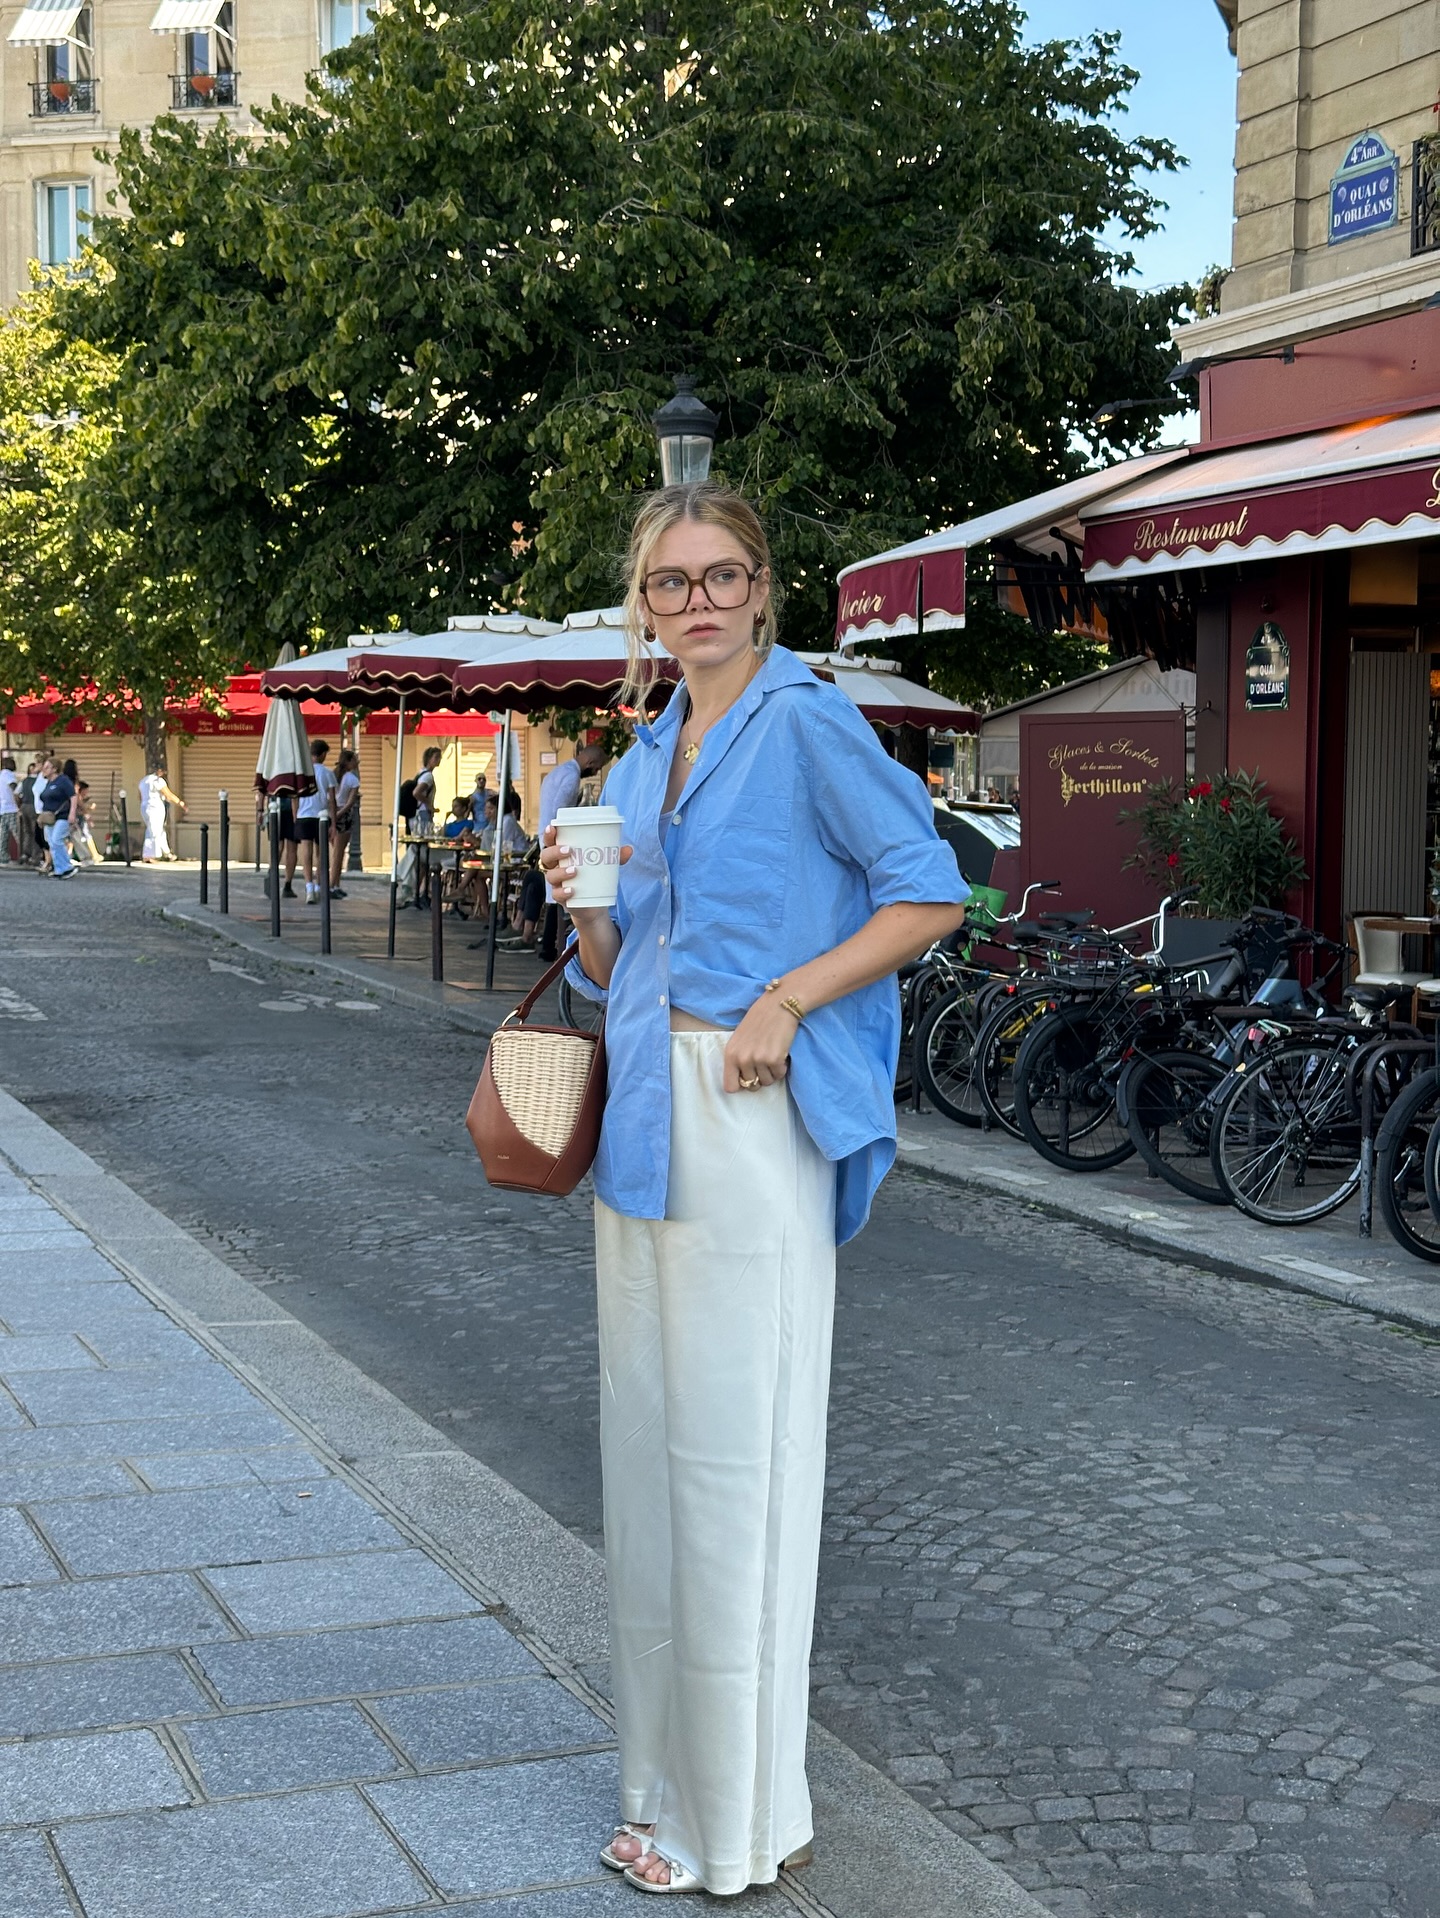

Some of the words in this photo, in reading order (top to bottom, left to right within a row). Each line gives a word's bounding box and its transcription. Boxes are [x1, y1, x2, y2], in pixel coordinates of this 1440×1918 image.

[1350, 180, 1377, 205] QUAI
[1333, 197, 1393, 228] D'ORLÉANS
[1133, 505, 1248, 551] Restaurant
[1259, 664, 1276, 677] QUAI
[1250, 680, 1285, 696] D'ORLÉANS
[1048, 743, 1090, 770] Glaces
[1094, 740, 1105, 754] &
[1109, 737, 1160, 769] Sorbets
[1097, 763, 1123, 771] maison
